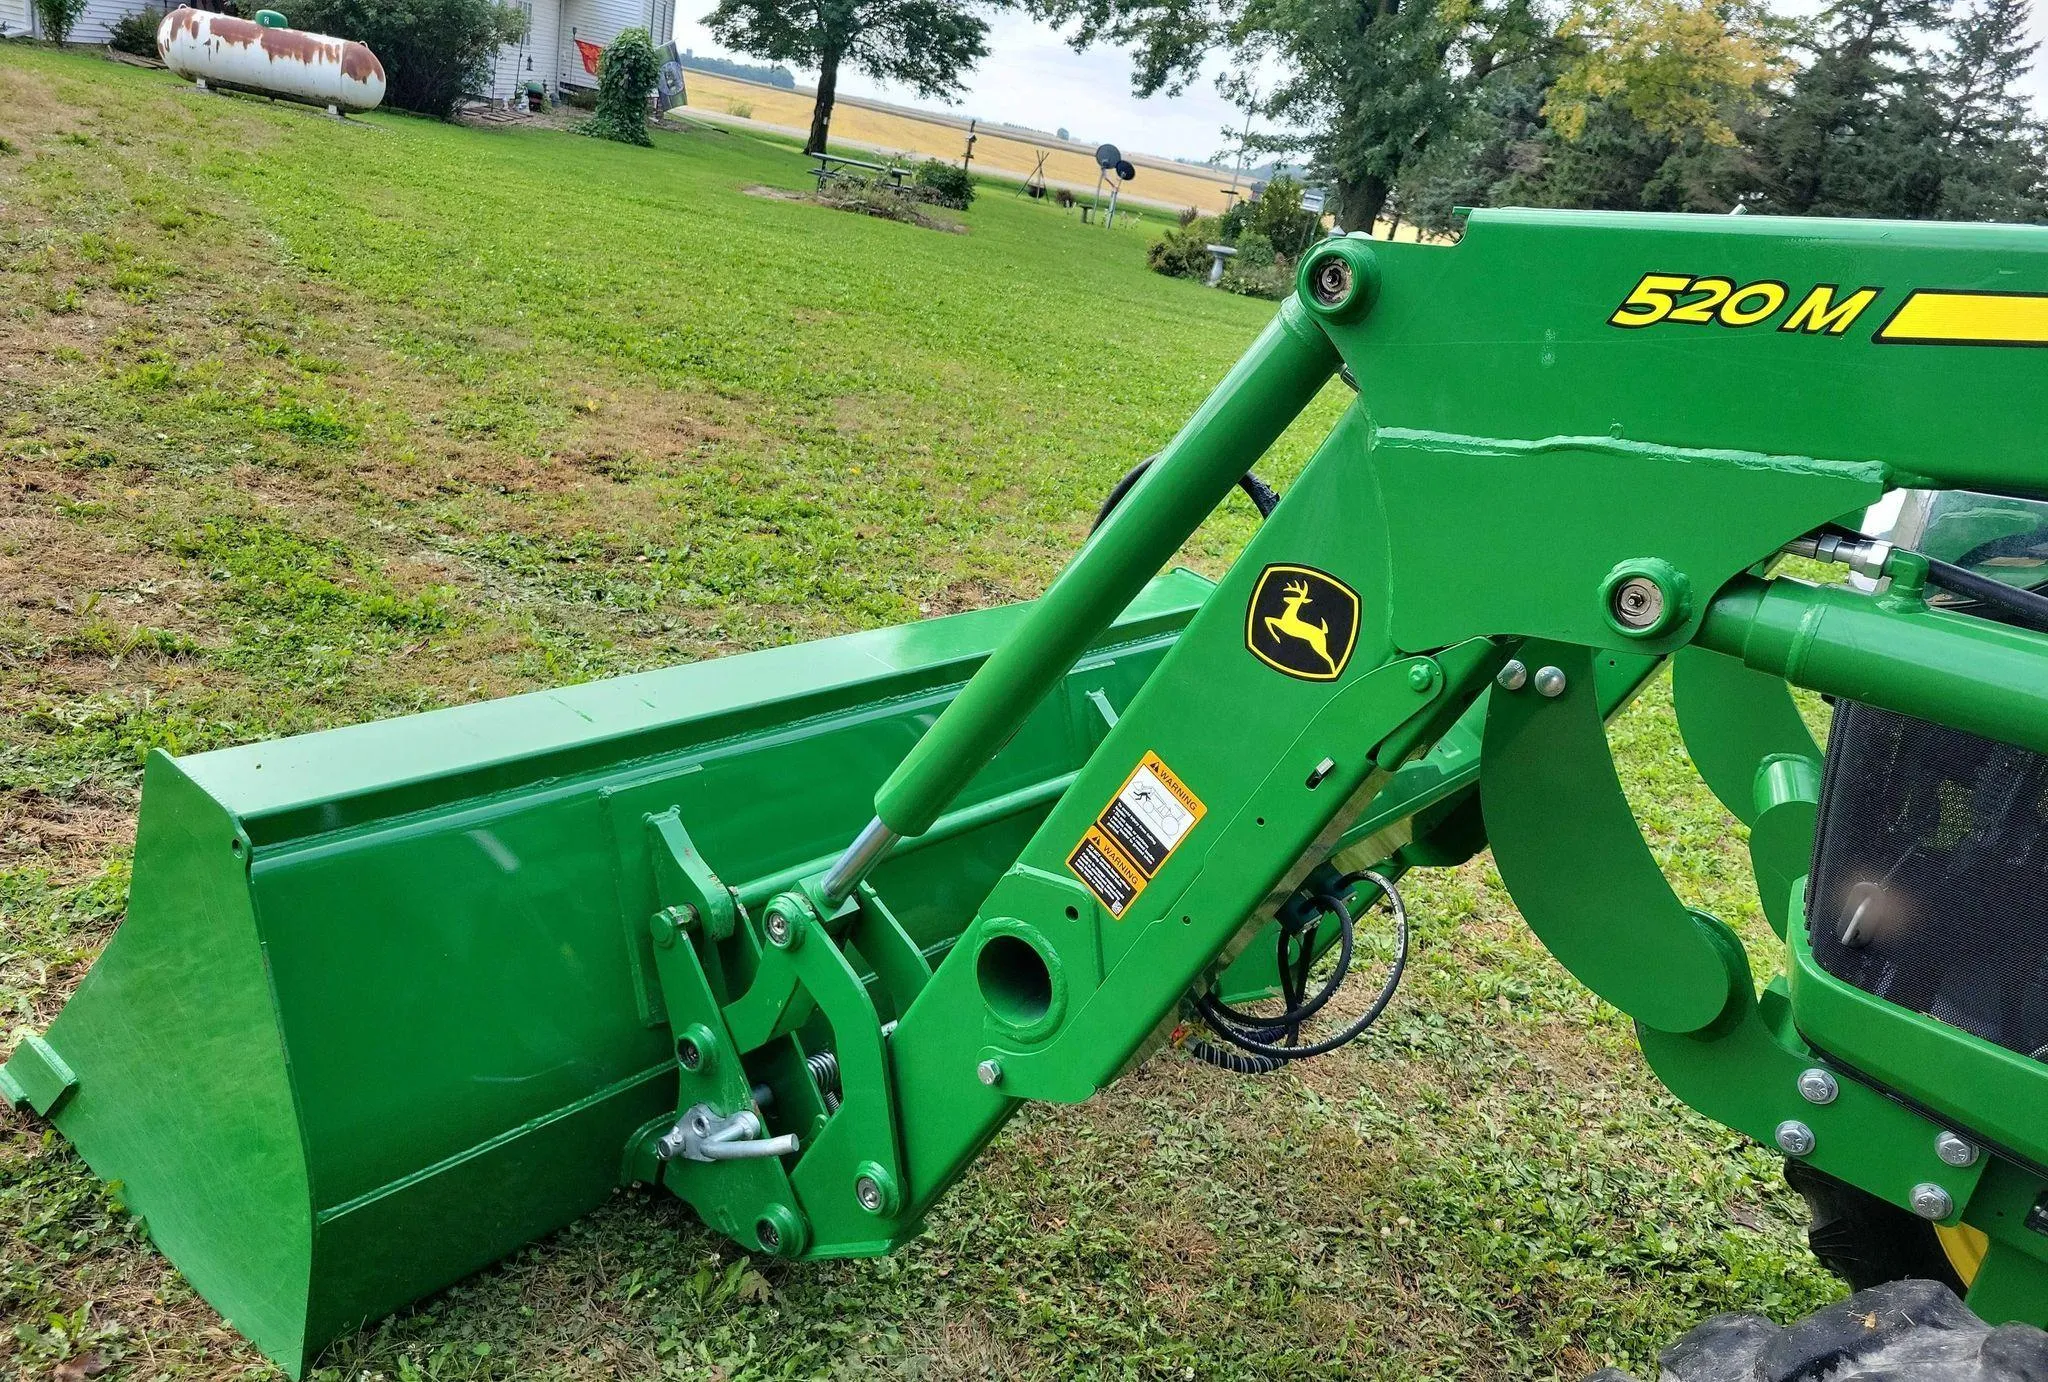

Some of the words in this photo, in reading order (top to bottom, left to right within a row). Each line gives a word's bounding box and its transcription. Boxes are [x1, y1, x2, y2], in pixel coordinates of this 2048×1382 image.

[1607, 272, 1788, 328] 520
[1777, 282, 1884, 335] M
[1159, 770, 1197, 810] WARNING
[1102, 844, 1139, 884] WARNING
